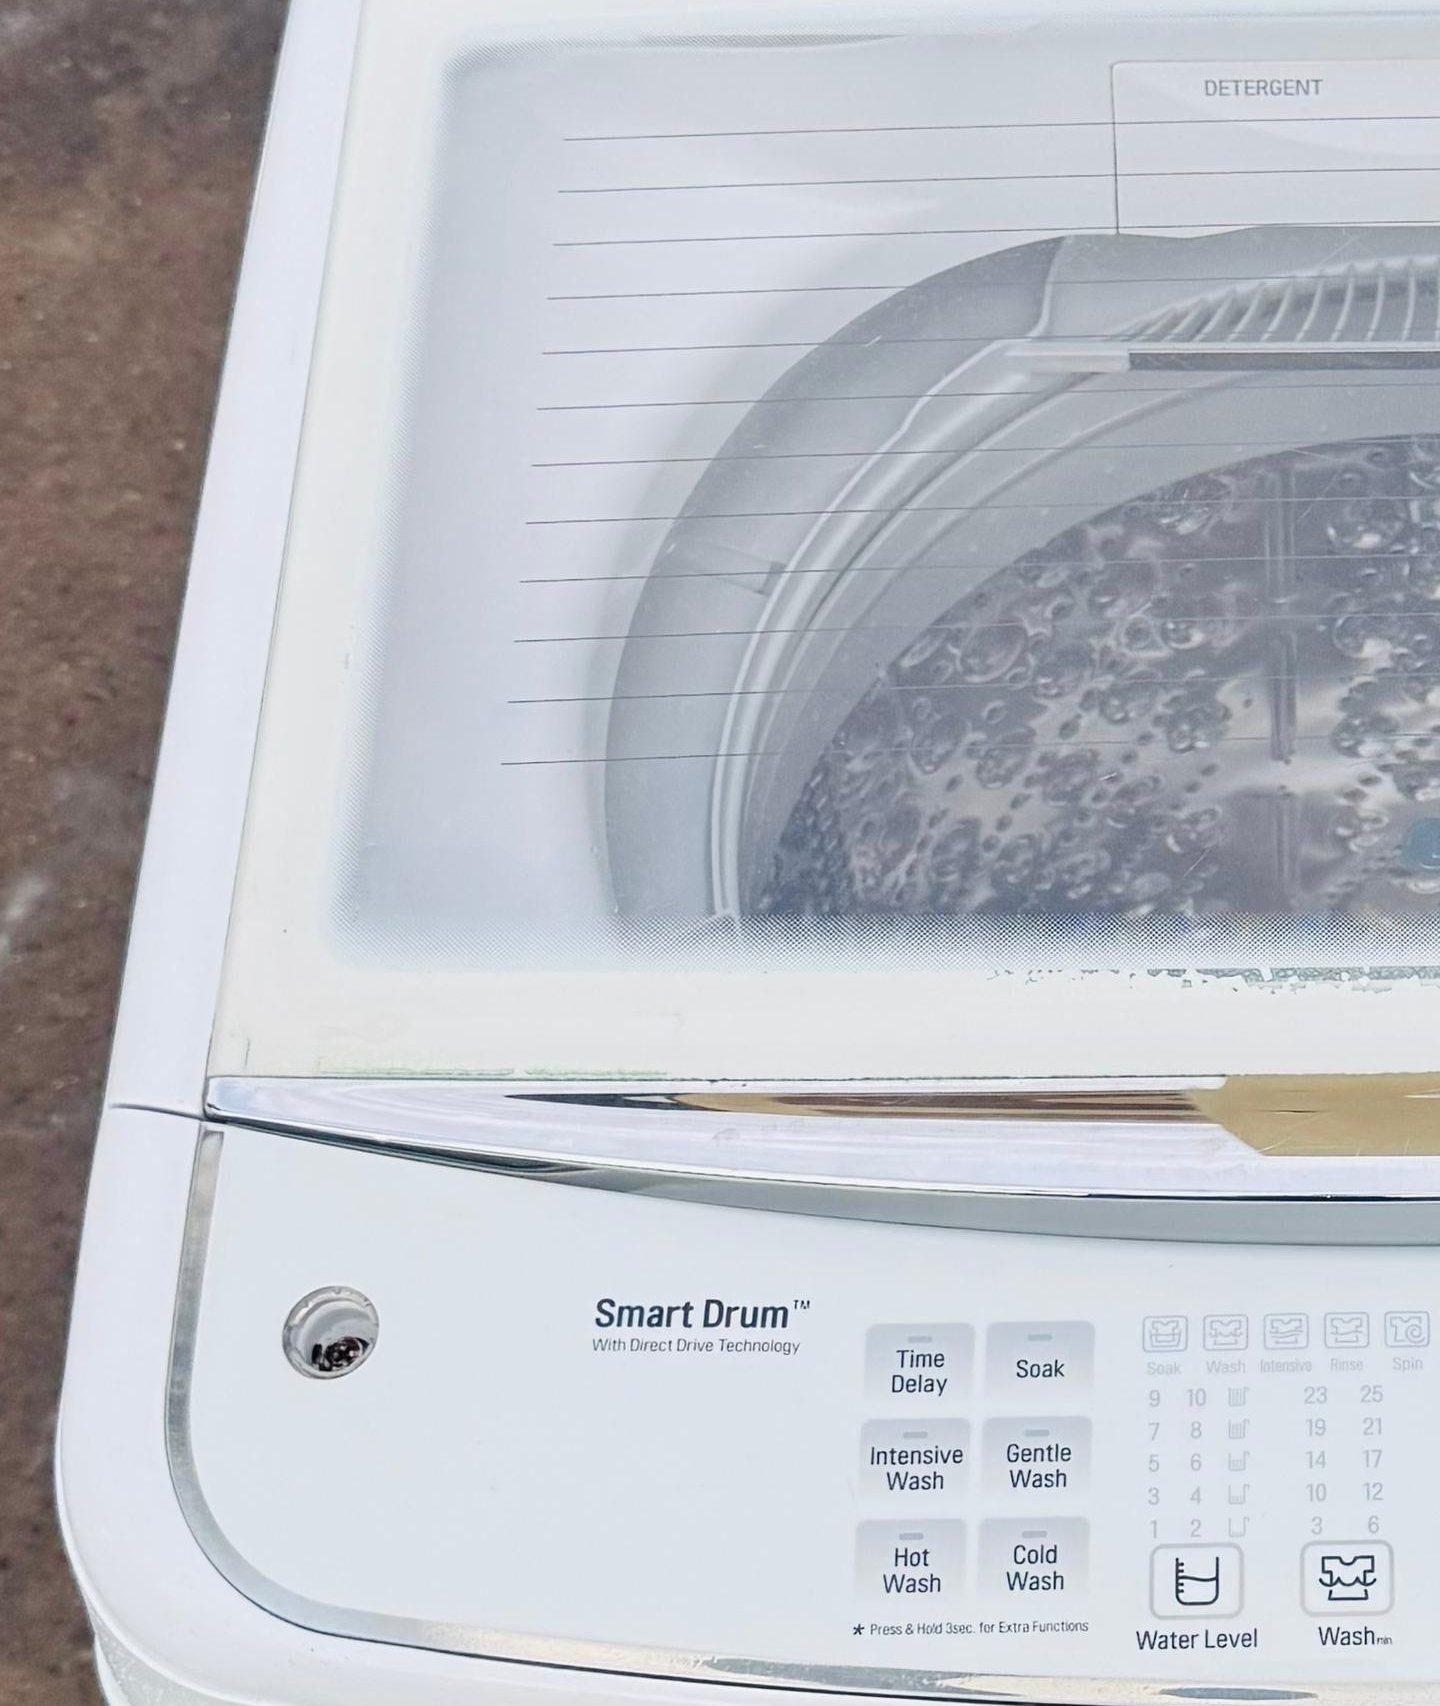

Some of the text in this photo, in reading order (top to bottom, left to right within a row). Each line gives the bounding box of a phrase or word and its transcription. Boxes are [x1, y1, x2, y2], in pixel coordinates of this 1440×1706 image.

[1204, 78, 1324, 97] DETERGENT
[594, 1298, 695, 1329] Smart
[592, 1337, 801, 1356] With Direct Drive Technology
[895, 1349, 945, 1369] Time
[1016, 1358, 1065, 1379] Soak
[1146, 1361, 1182, 1376] Soak
[1205, 1359, 1246, 1374] Wash
[1259, 1357, 1313, 1374] Intensive
[1330, 1357, 1364, 1372] Rinse
[1392, 1356, 1424, 1374] Spin
[891, 1373, 948, 1397] Delay
[1303, 1384, 1384, 1405] 23 25
[1148, 1387, 1207, 1408] 9 10
[1148, 1420, 1203, 1441] 7 8
[1305, 1416, 1383, 1438] 19 21
[870, 1445, 964, 1466] Intensive
[1006, 1443, 1072, 1463] Gentle
[1147, 1452, 1203, 1473] 5 6
[1305, 1449, 1383, 1470] 14 17
[886, 1470, 944, 1491] Wash
[1009, 1468, 1067, 1489] Wash
[1147, 1485, 1202, 1506] 3 4
[1305, 1482, 1384, 1503] 10 12
[1150, 1518, 1202, 1540] 1 2
[1310, 1514, 1380, 1536] 3 6
[894, 1547, 930, 1567] Hot
[1013, 1544, 1058, 1565] Cold
[882, 1572, 941, 1594] Wash
[1006, 1570, 1064, 1591] Wash
[870, 1623, 903, 1636] Press
[979, 1621, 996, 1634] for
[998, 1620, 1030, 1634] Extra
[1032, 1620, 1089, 1633] Functions
[1317, 1625, 1375, 1646] Wash
[1135, 1627, 1258, 1651] Water Level
